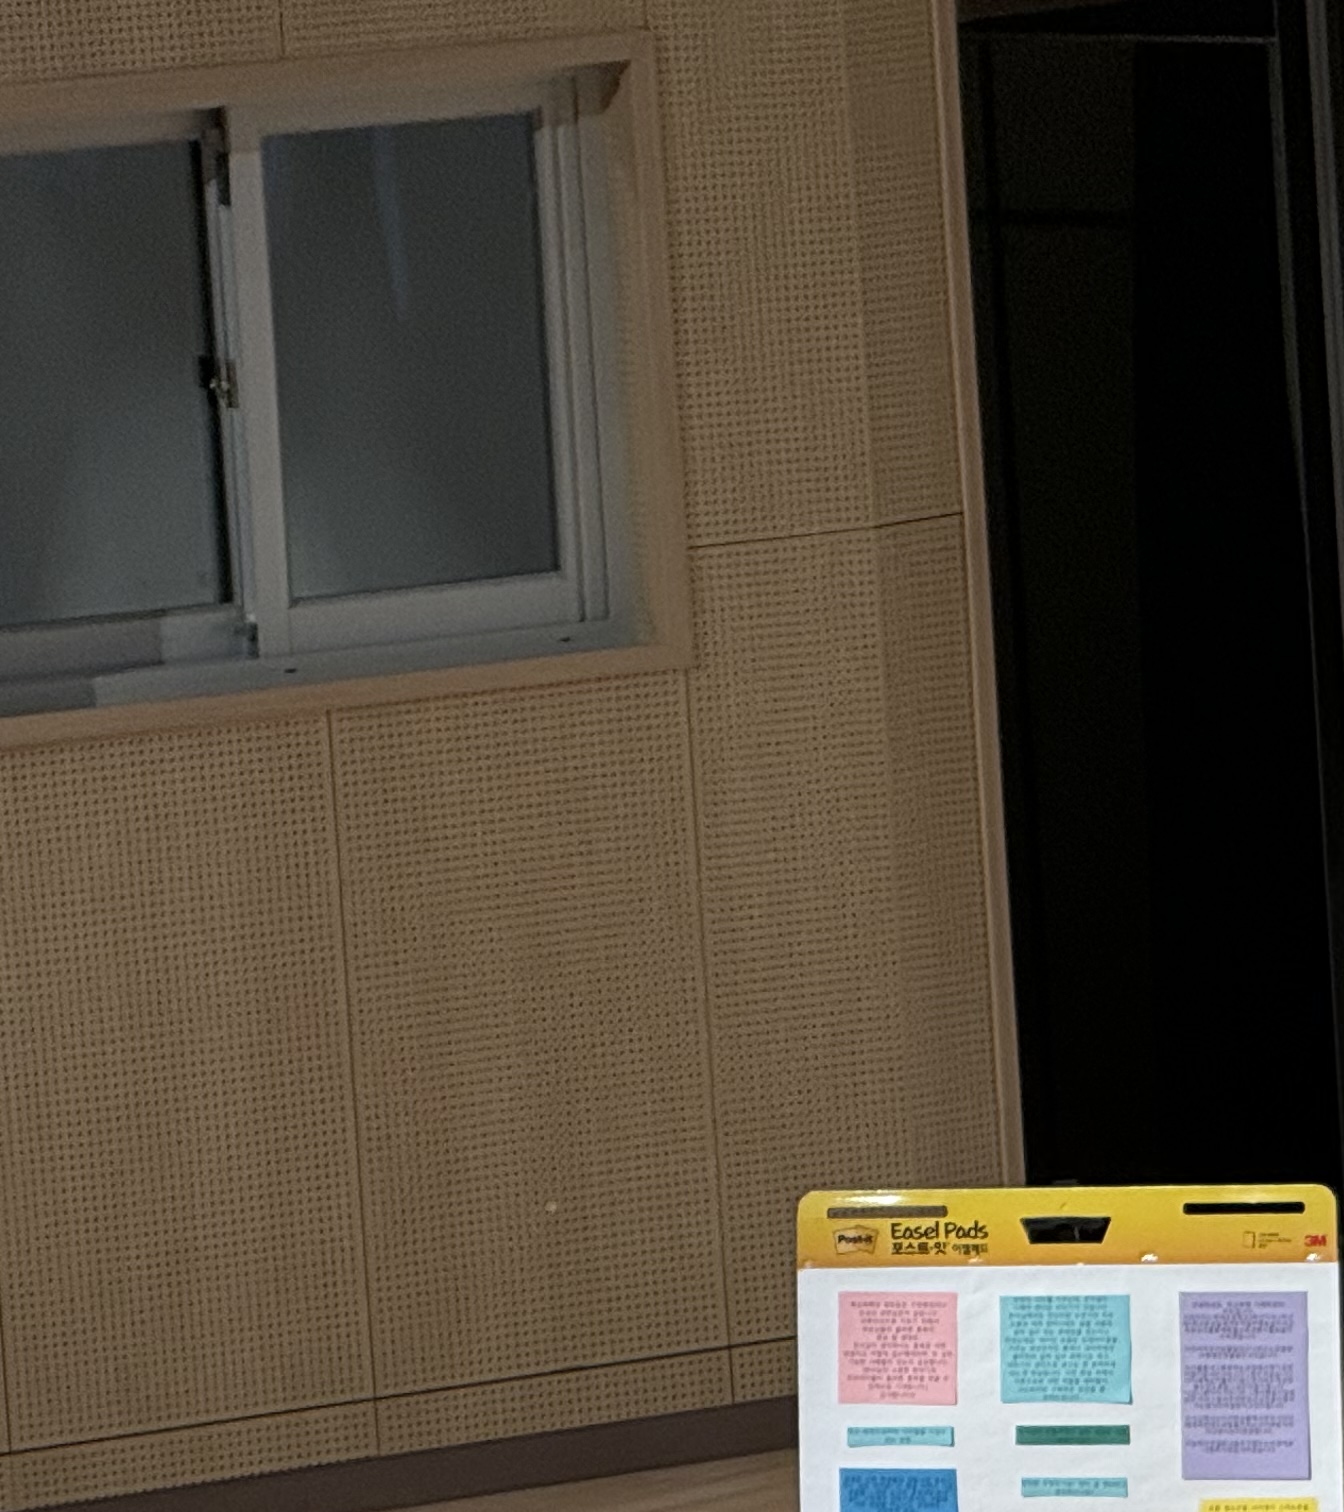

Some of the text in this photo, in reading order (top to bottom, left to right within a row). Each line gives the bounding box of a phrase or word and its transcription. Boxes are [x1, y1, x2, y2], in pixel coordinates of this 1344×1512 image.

[890, 1220, 989, 1240] Easel Pads
[837, 1234, 874, 1245] Post-it
[1304, 1234, 1328, 1248] 3M
